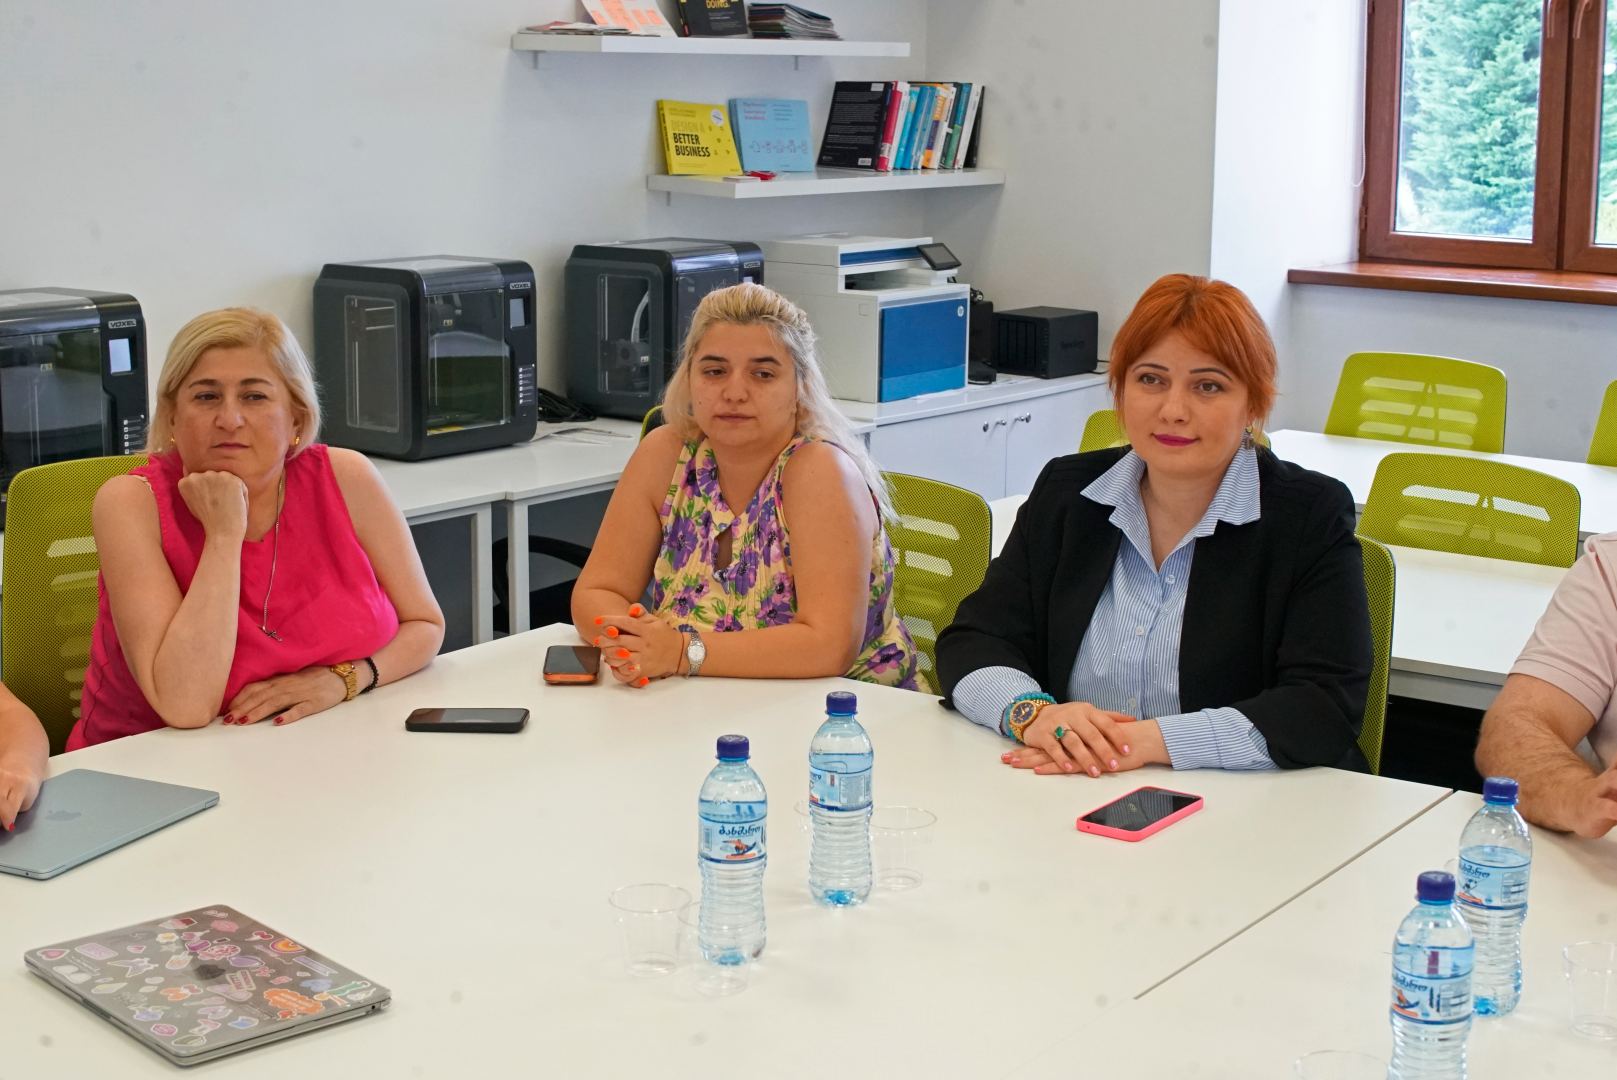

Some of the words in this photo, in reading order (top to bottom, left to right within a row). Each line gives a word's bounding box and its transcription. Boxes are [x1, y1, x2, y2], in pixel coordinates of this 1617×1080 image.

[671, 120, 699, 133] DESIGN
[700, 123, 706, 133] A
[673, 133, 700, 145] BETTER
[675, 145, 711, 158] BUSINESS
